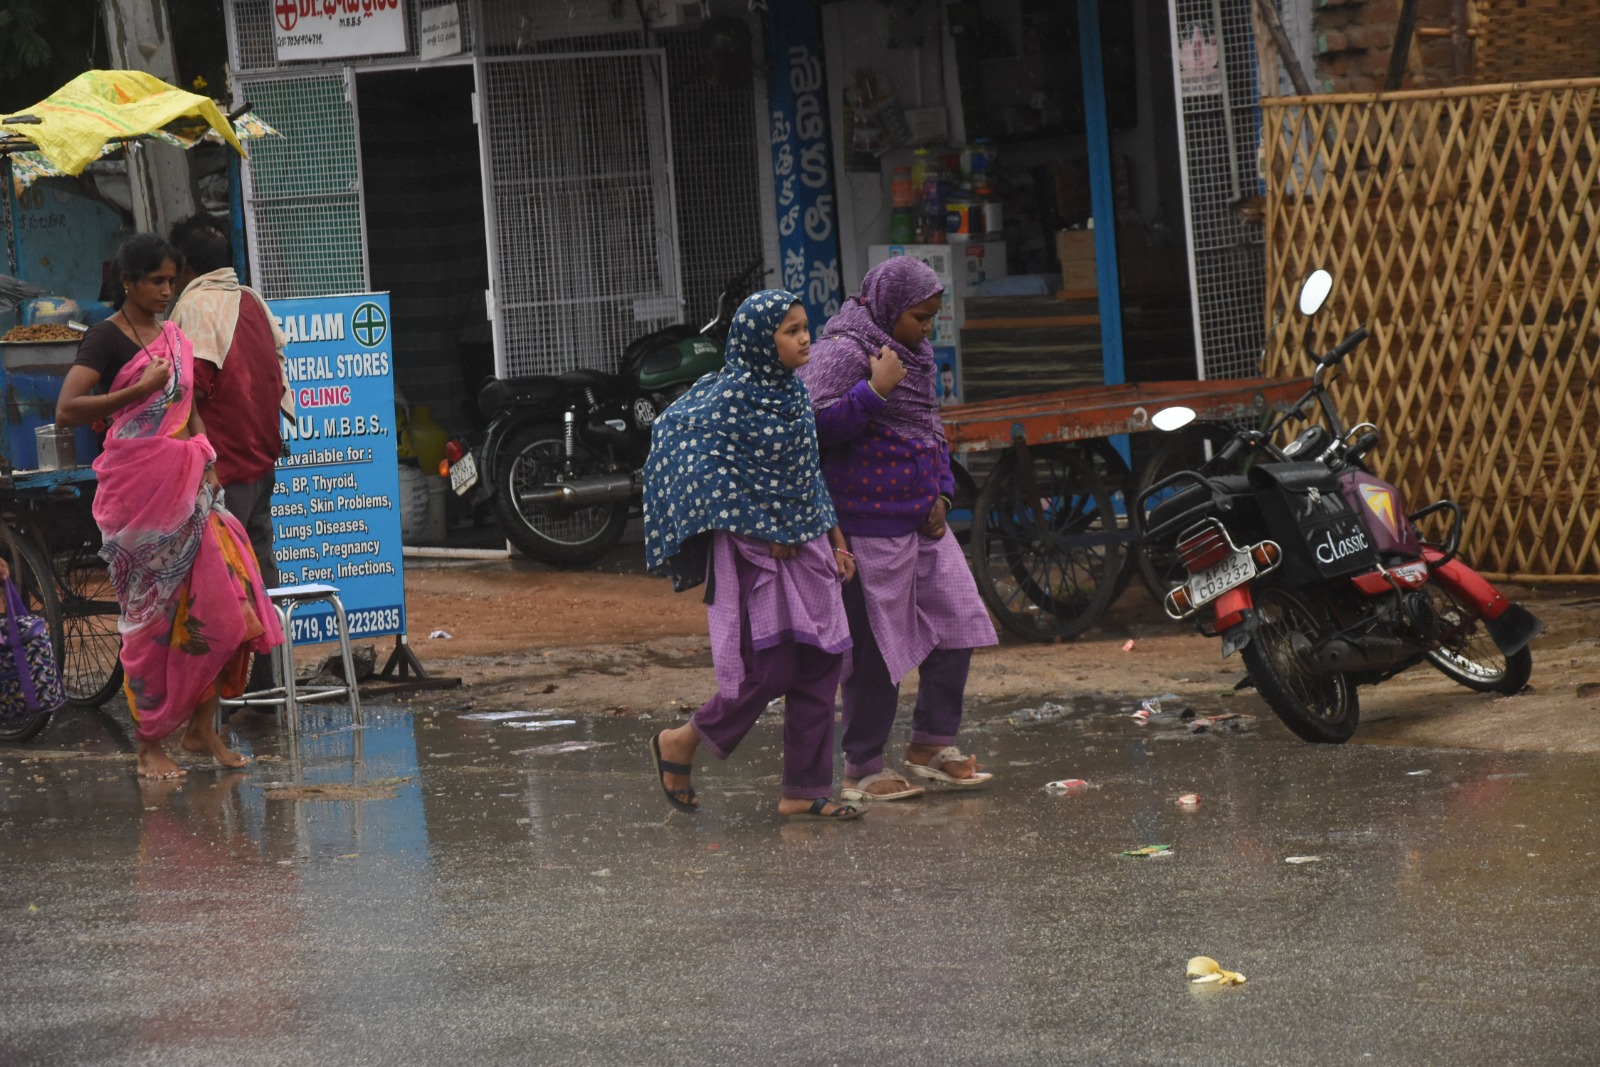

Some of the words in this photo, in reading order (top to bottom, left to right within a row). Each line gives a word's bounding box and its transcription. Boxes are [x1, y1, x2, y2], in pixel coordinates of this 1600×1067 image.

[336, 351, 389, 379] STORES
[299, 384, 351, 409] CLINIC
[280, 415, 321, 441] NU.
[287, 448, 344, 467] available
[292, 476, 310, 494] BP,
[312, 473, 358, 493] Thyroid,
[271, 503, 307, 517] eases,
[310, 497, 334, 513] Skin
[337, 494, 392, 510] Problems,
[278, 523, 313, 541] Lungs
[315, 519, 368, 535] Diseases,
[273, 545, 320, 562] oblems,
[322, 540, 380, 559] Pregnancy
[302, 566, 335, 583] Fever,
[337, 560, 395, 578] Infections,
[325, 608, 400, 637] 992232835
